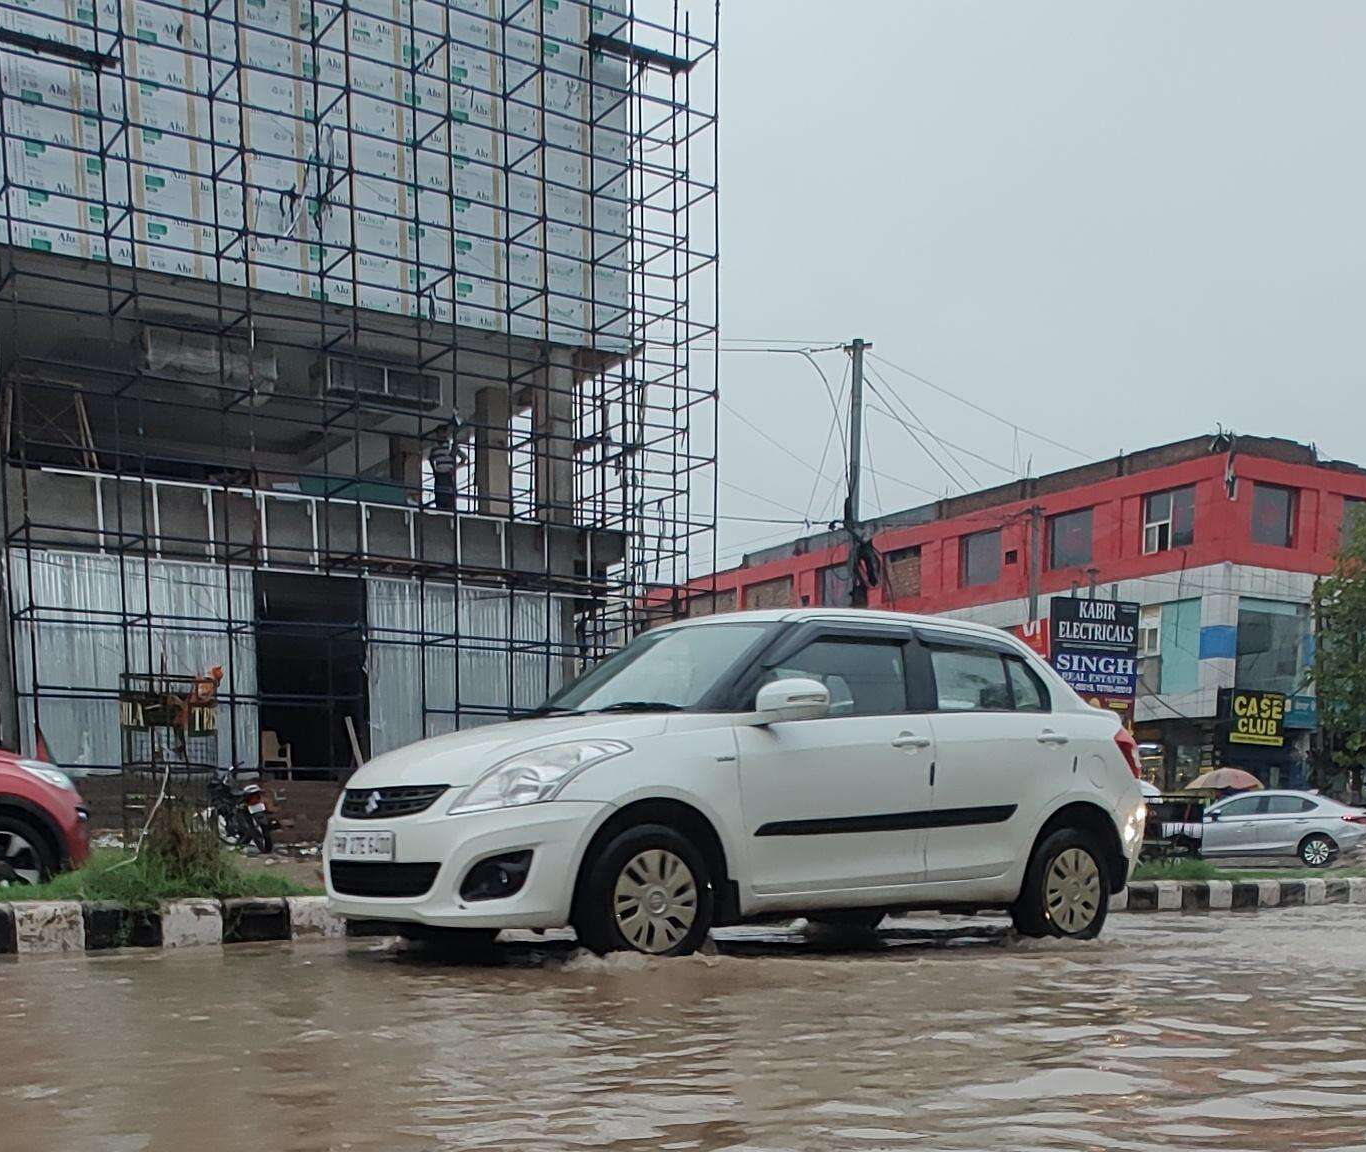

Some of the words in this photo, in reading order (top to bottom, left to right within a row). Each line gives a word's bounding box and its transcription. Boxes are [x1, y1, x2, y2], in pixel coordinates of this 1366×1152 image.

[1079, 601, 1116, 620] KABIR
[1058, 620, 1134, 643] ELECTRICALS
[1056, 653, 1134, 675] SINGH
[1062, 671, 1087, 682] REAL
[1089, 673, 1129, 685] ESTATES
[1234, 696, 1283, 720] CASE
[1237, 718, 1277, 736] CLUB
